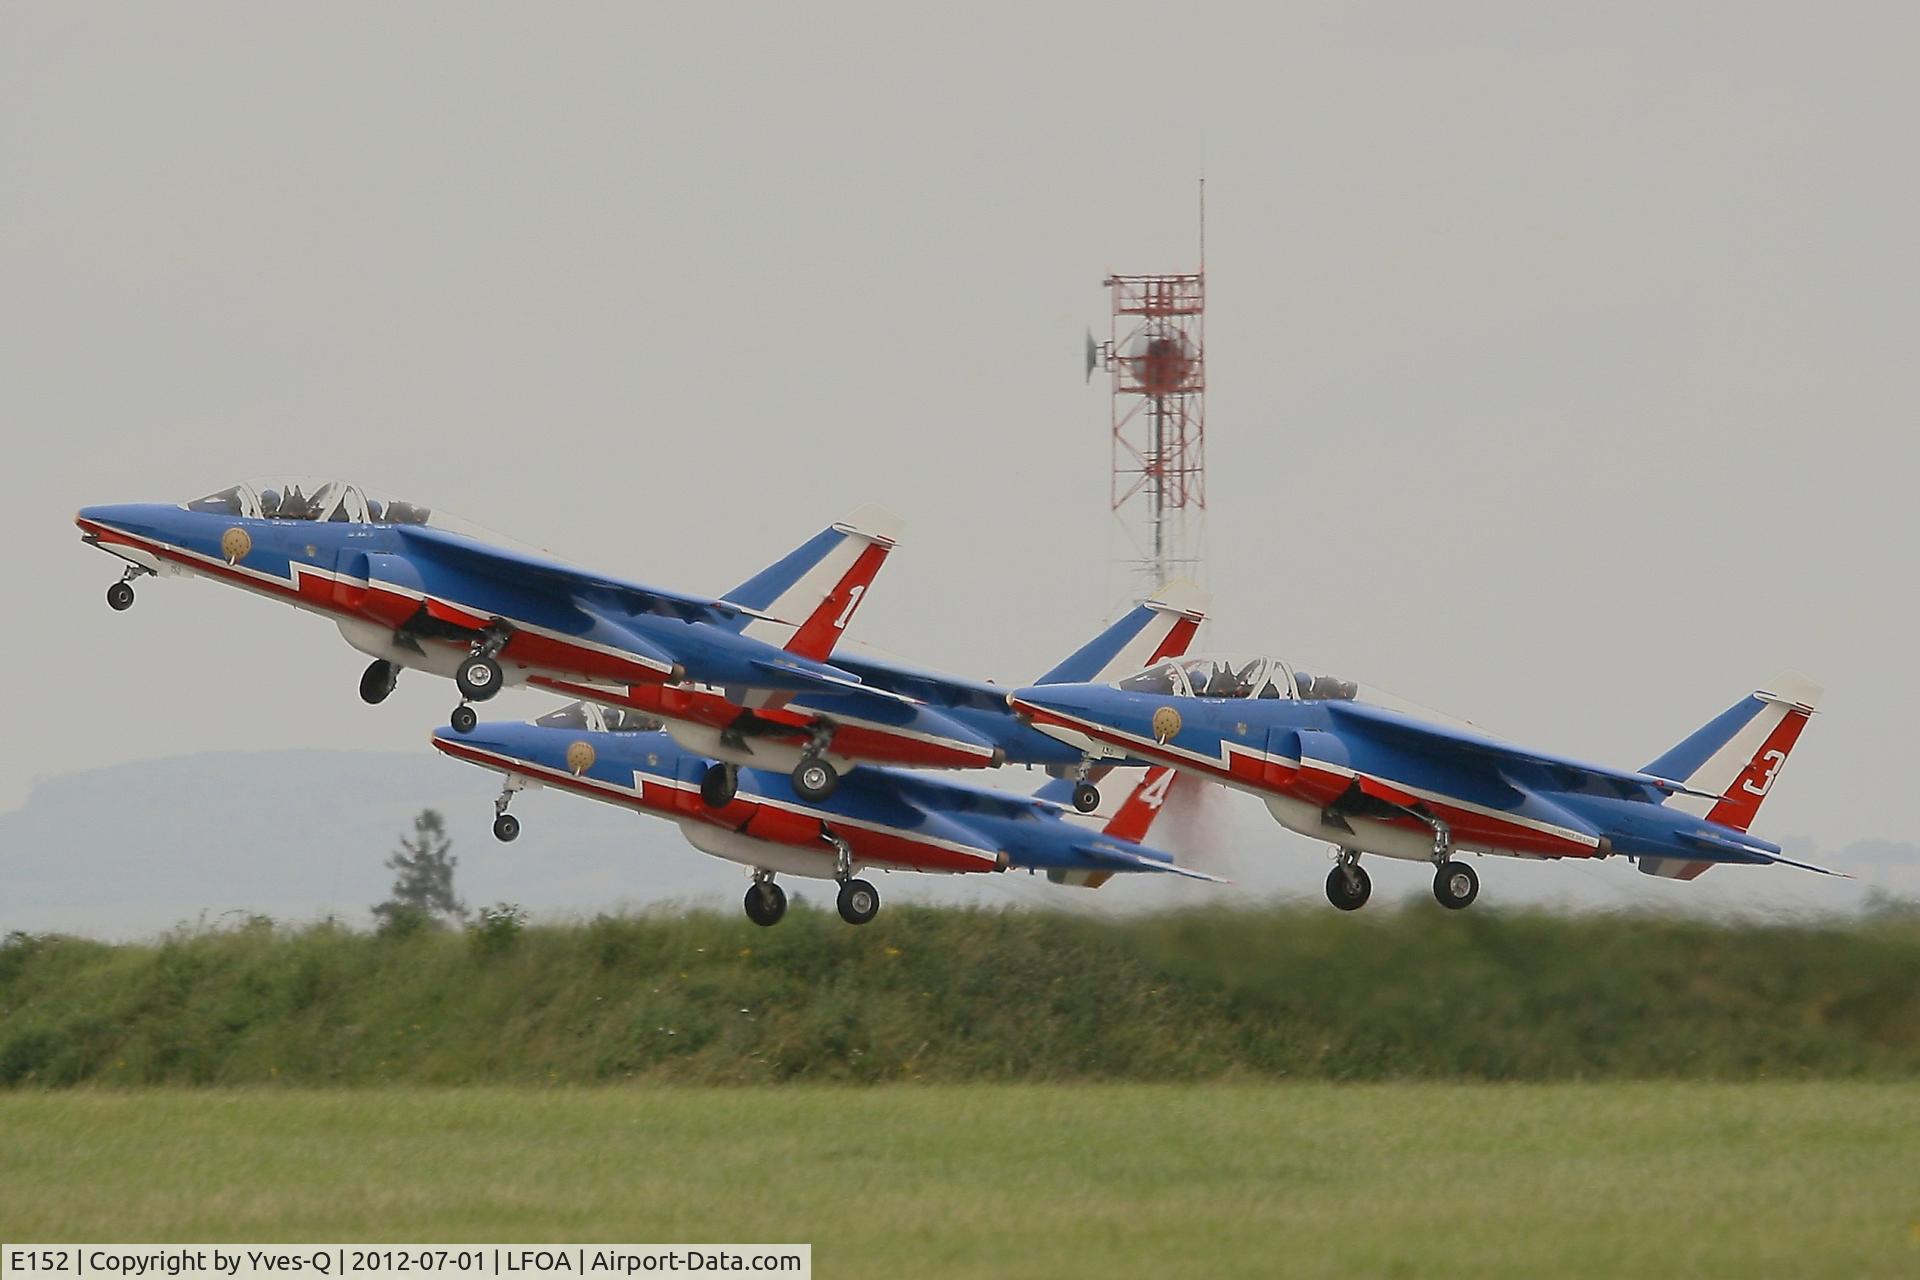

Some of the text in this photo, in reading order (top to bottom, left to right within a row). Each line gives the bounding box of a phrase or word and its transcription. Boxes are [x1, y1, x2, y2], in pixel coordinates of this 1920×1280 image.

[834, 585, 865, 629] 1
[1139, 768, 1176, 809] 4
[1743, 750, 1786, 796] 3
